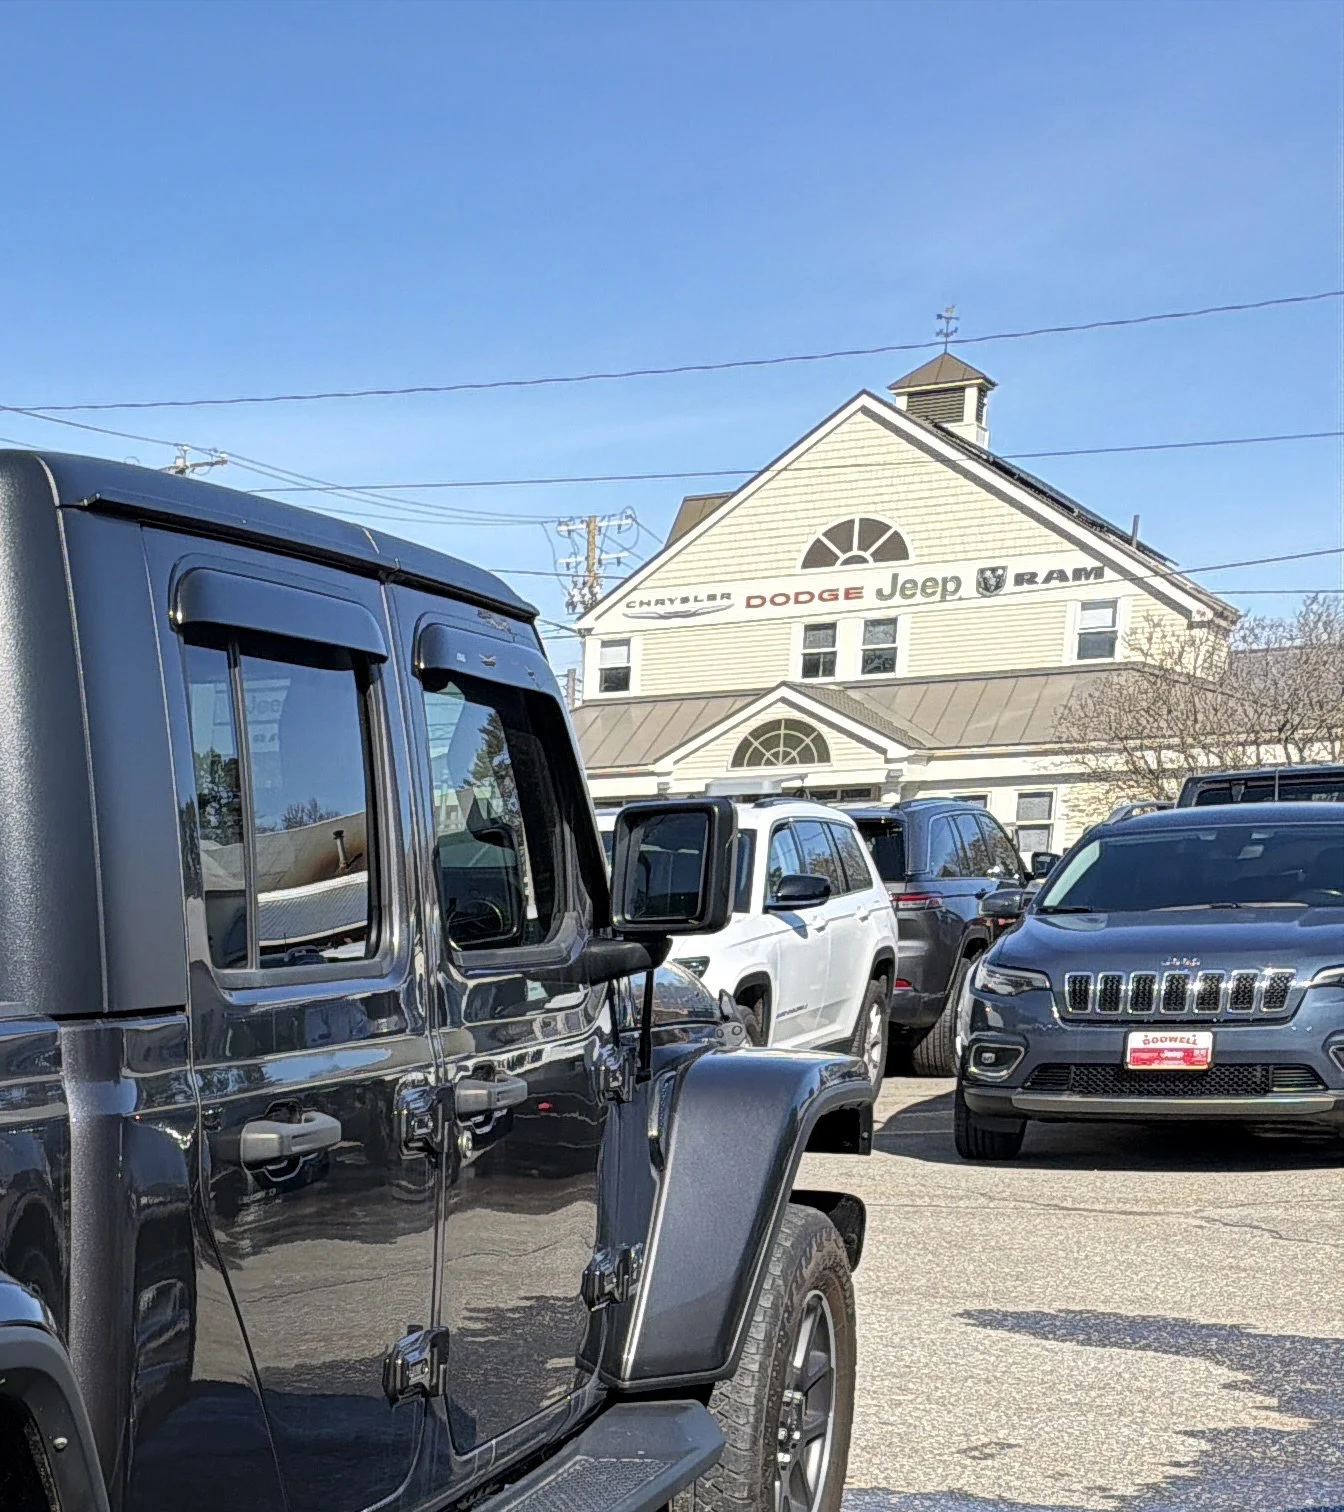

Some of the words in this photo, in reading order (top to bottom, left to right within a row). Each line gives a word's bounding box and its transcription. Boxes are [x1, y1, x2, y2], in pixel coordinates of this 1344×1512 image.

[625, 592, 732, 609] CHRYSLER
[745, 586, 865, 609] DODGE
[875, 573, 963, 602] Jeep
[1013, 565, 1106, 588] RAM
